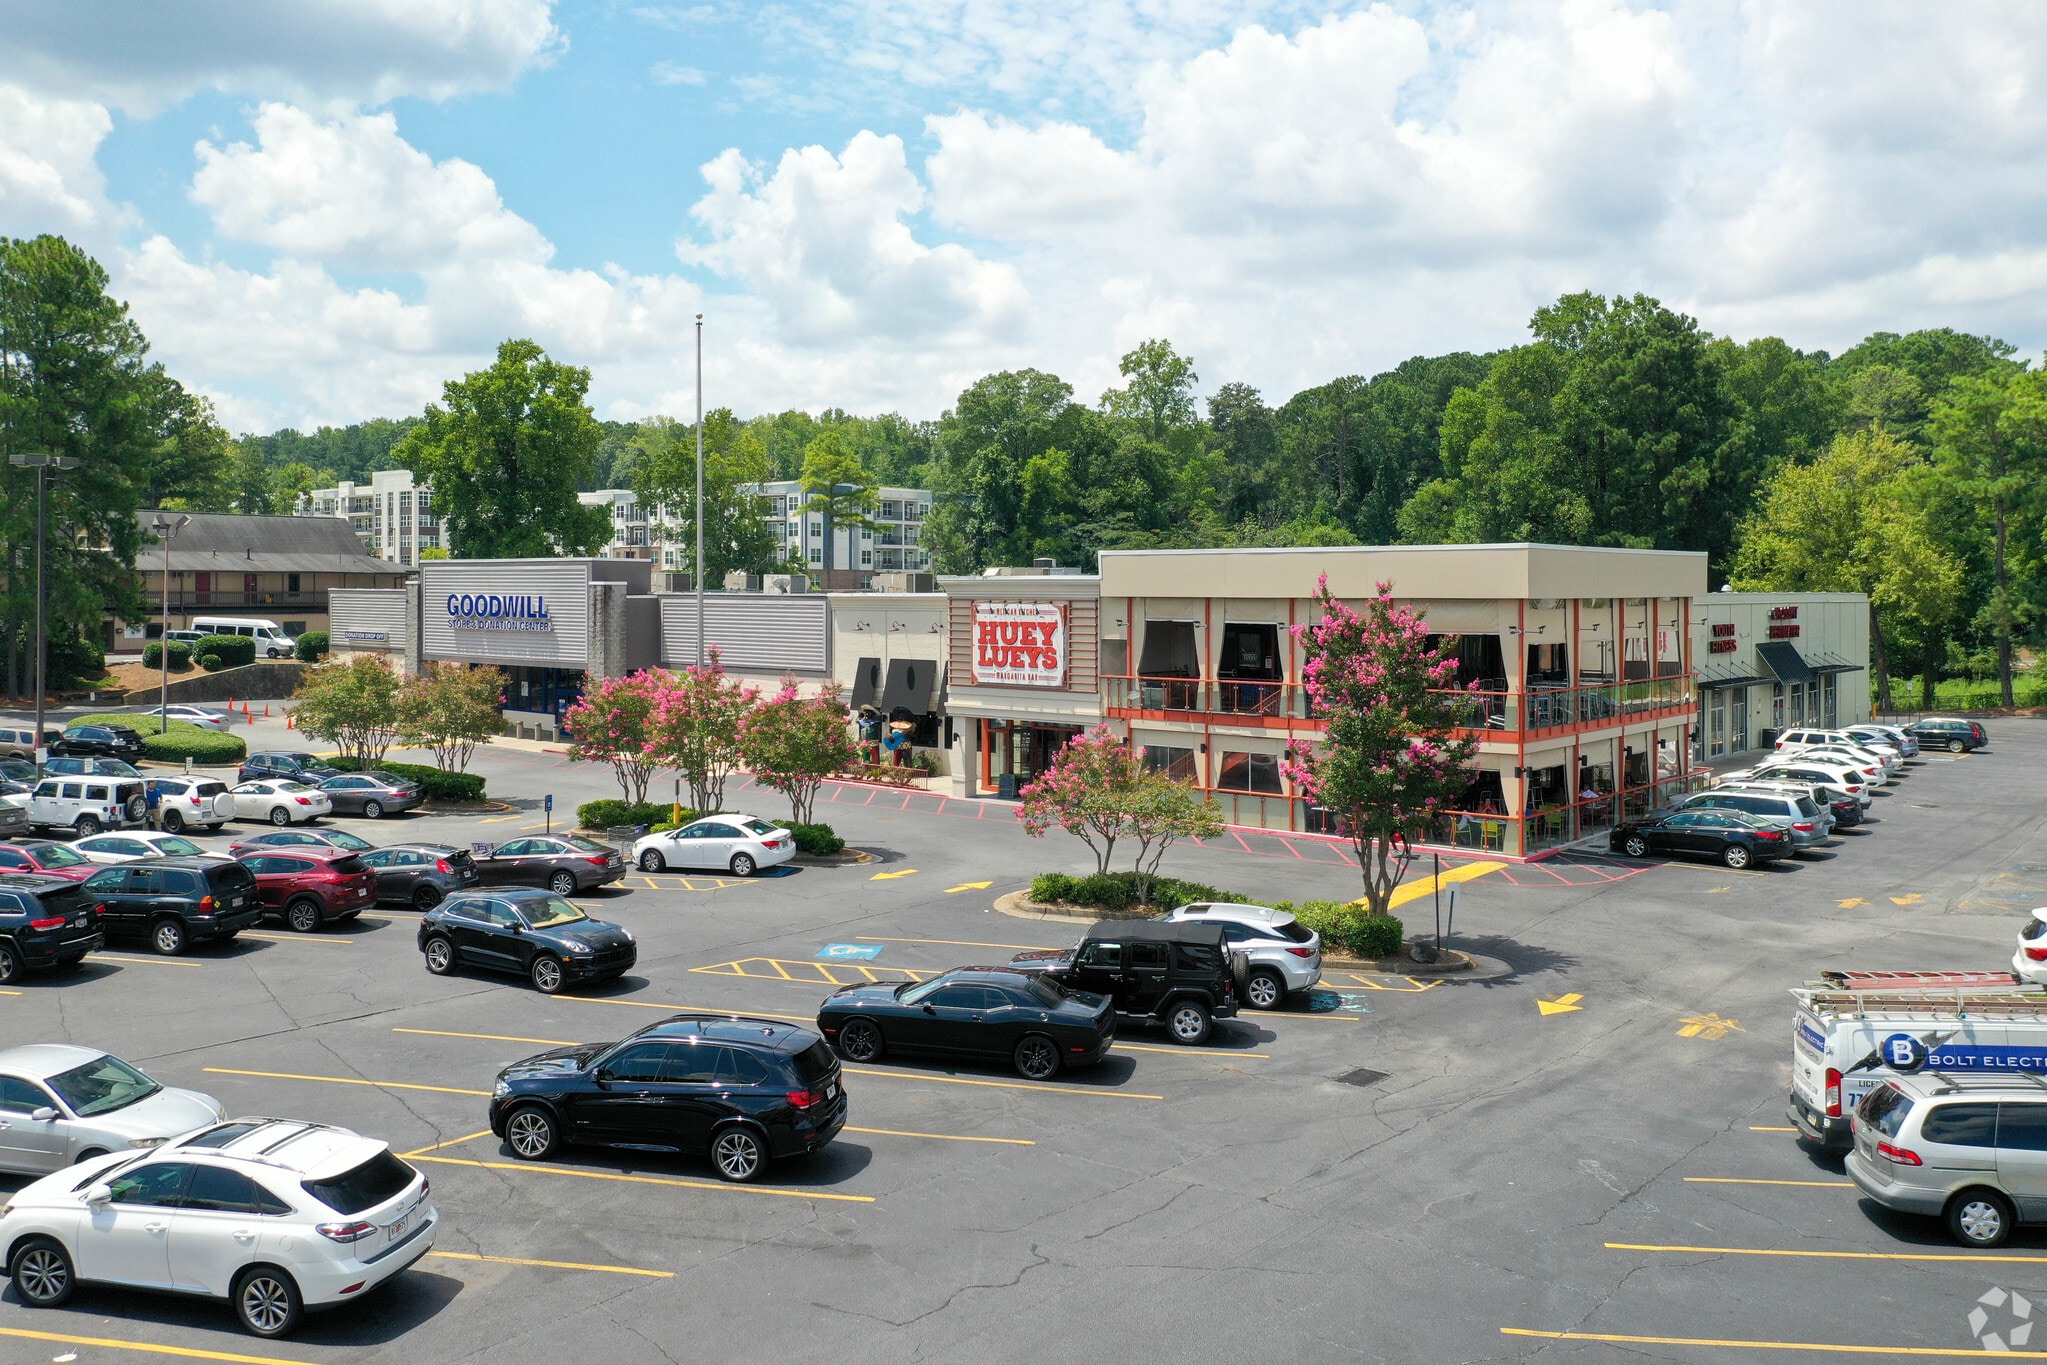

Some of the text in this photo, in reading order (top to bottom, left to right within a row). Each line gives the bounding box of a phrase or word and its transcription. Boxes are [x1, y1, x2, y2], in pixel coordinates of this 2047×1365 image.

[447, 593, 549, 619] GOODWILL
[996, 607, 1038, 616] MECAN KCHE
[447, 619, 470, 629] STORE
[479, 620, 518, 630] DONATION
[520, 621, 551, 632] CENTER
[1713, 624, 1736, 637] YOUTH
[977, 621, 1058, 646] HUEY
[1711, 639, 1738, 654] FITNESS
[996, 672, 1038, 681] MARGARITA BAR
[1891, 1040, 1914, 1065] B
[1929, 1055, 1976, 1066] BOLT
[1858, 1079, 1878, 1088] LICE
